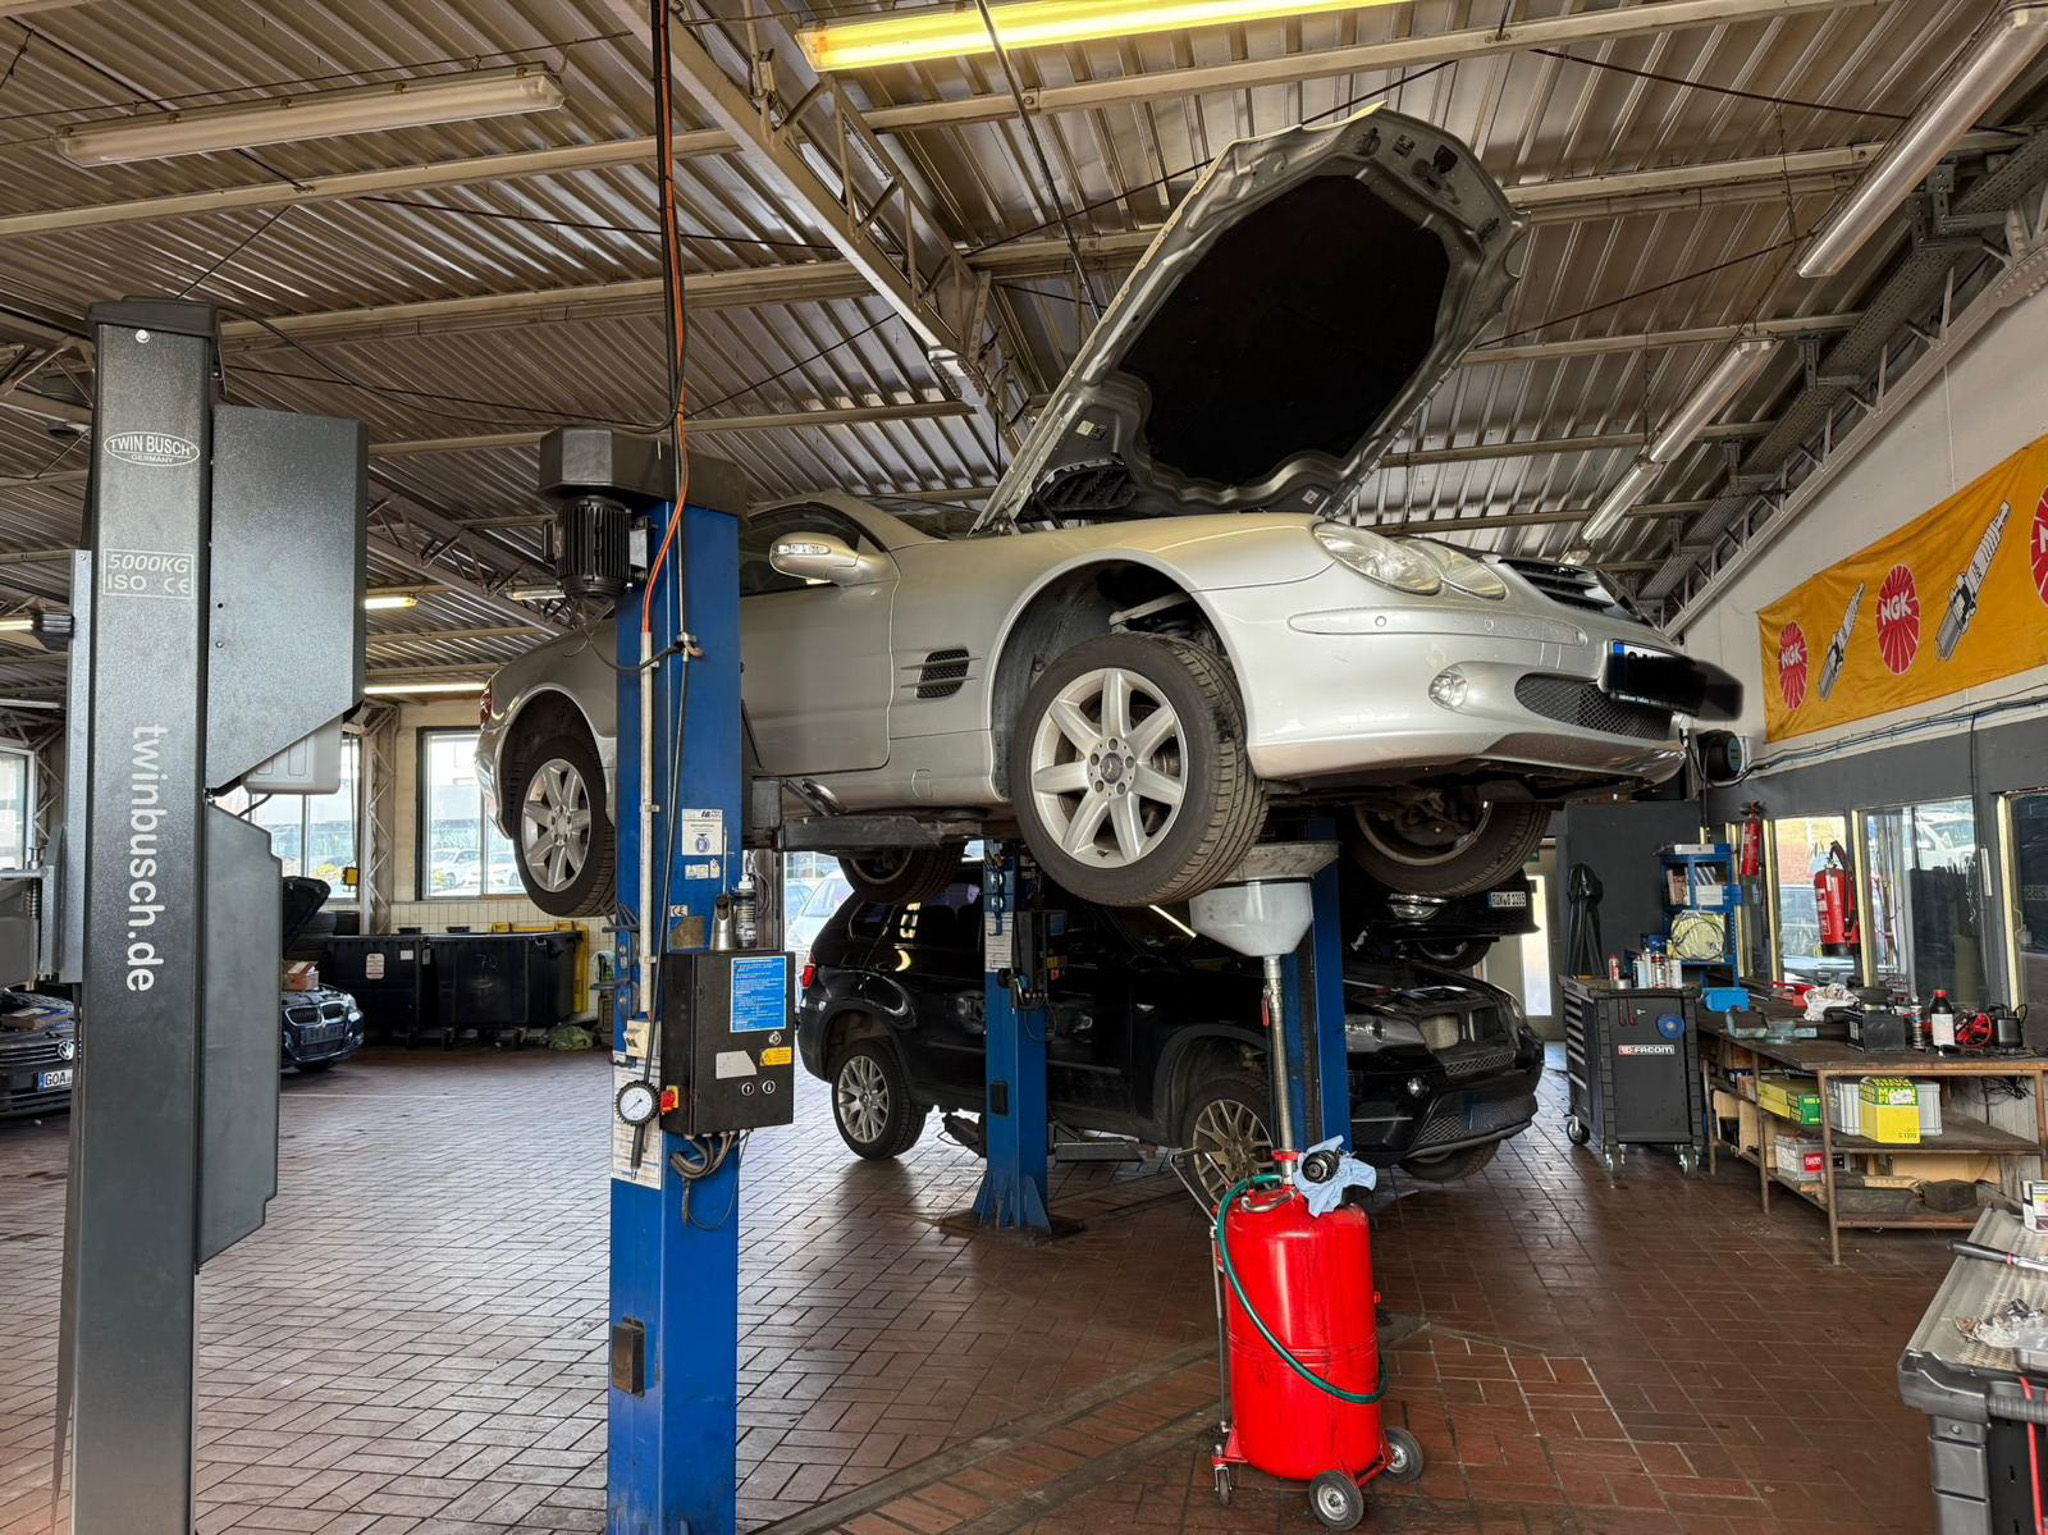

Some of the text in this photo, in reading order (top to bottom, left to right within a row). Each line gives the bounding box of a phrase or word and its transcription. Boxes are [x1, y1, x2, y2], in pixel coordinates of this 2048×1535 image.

[110, 435, 191, 456] TWIN BUSCH
[131, 454, 174, 463] GERMANY
[108, 554, 190, 573] 5000KG
[107, 573, 147, 591] ISO
[1881, 589, 1912, 626] NGK
[1781, 641, 1803, 669] NGK
[126, 724, 168, 992] twinbusch.de
[1634, 1044, 1674, 1055] FACOM
[45, 1071, 67, 1087] GOA
